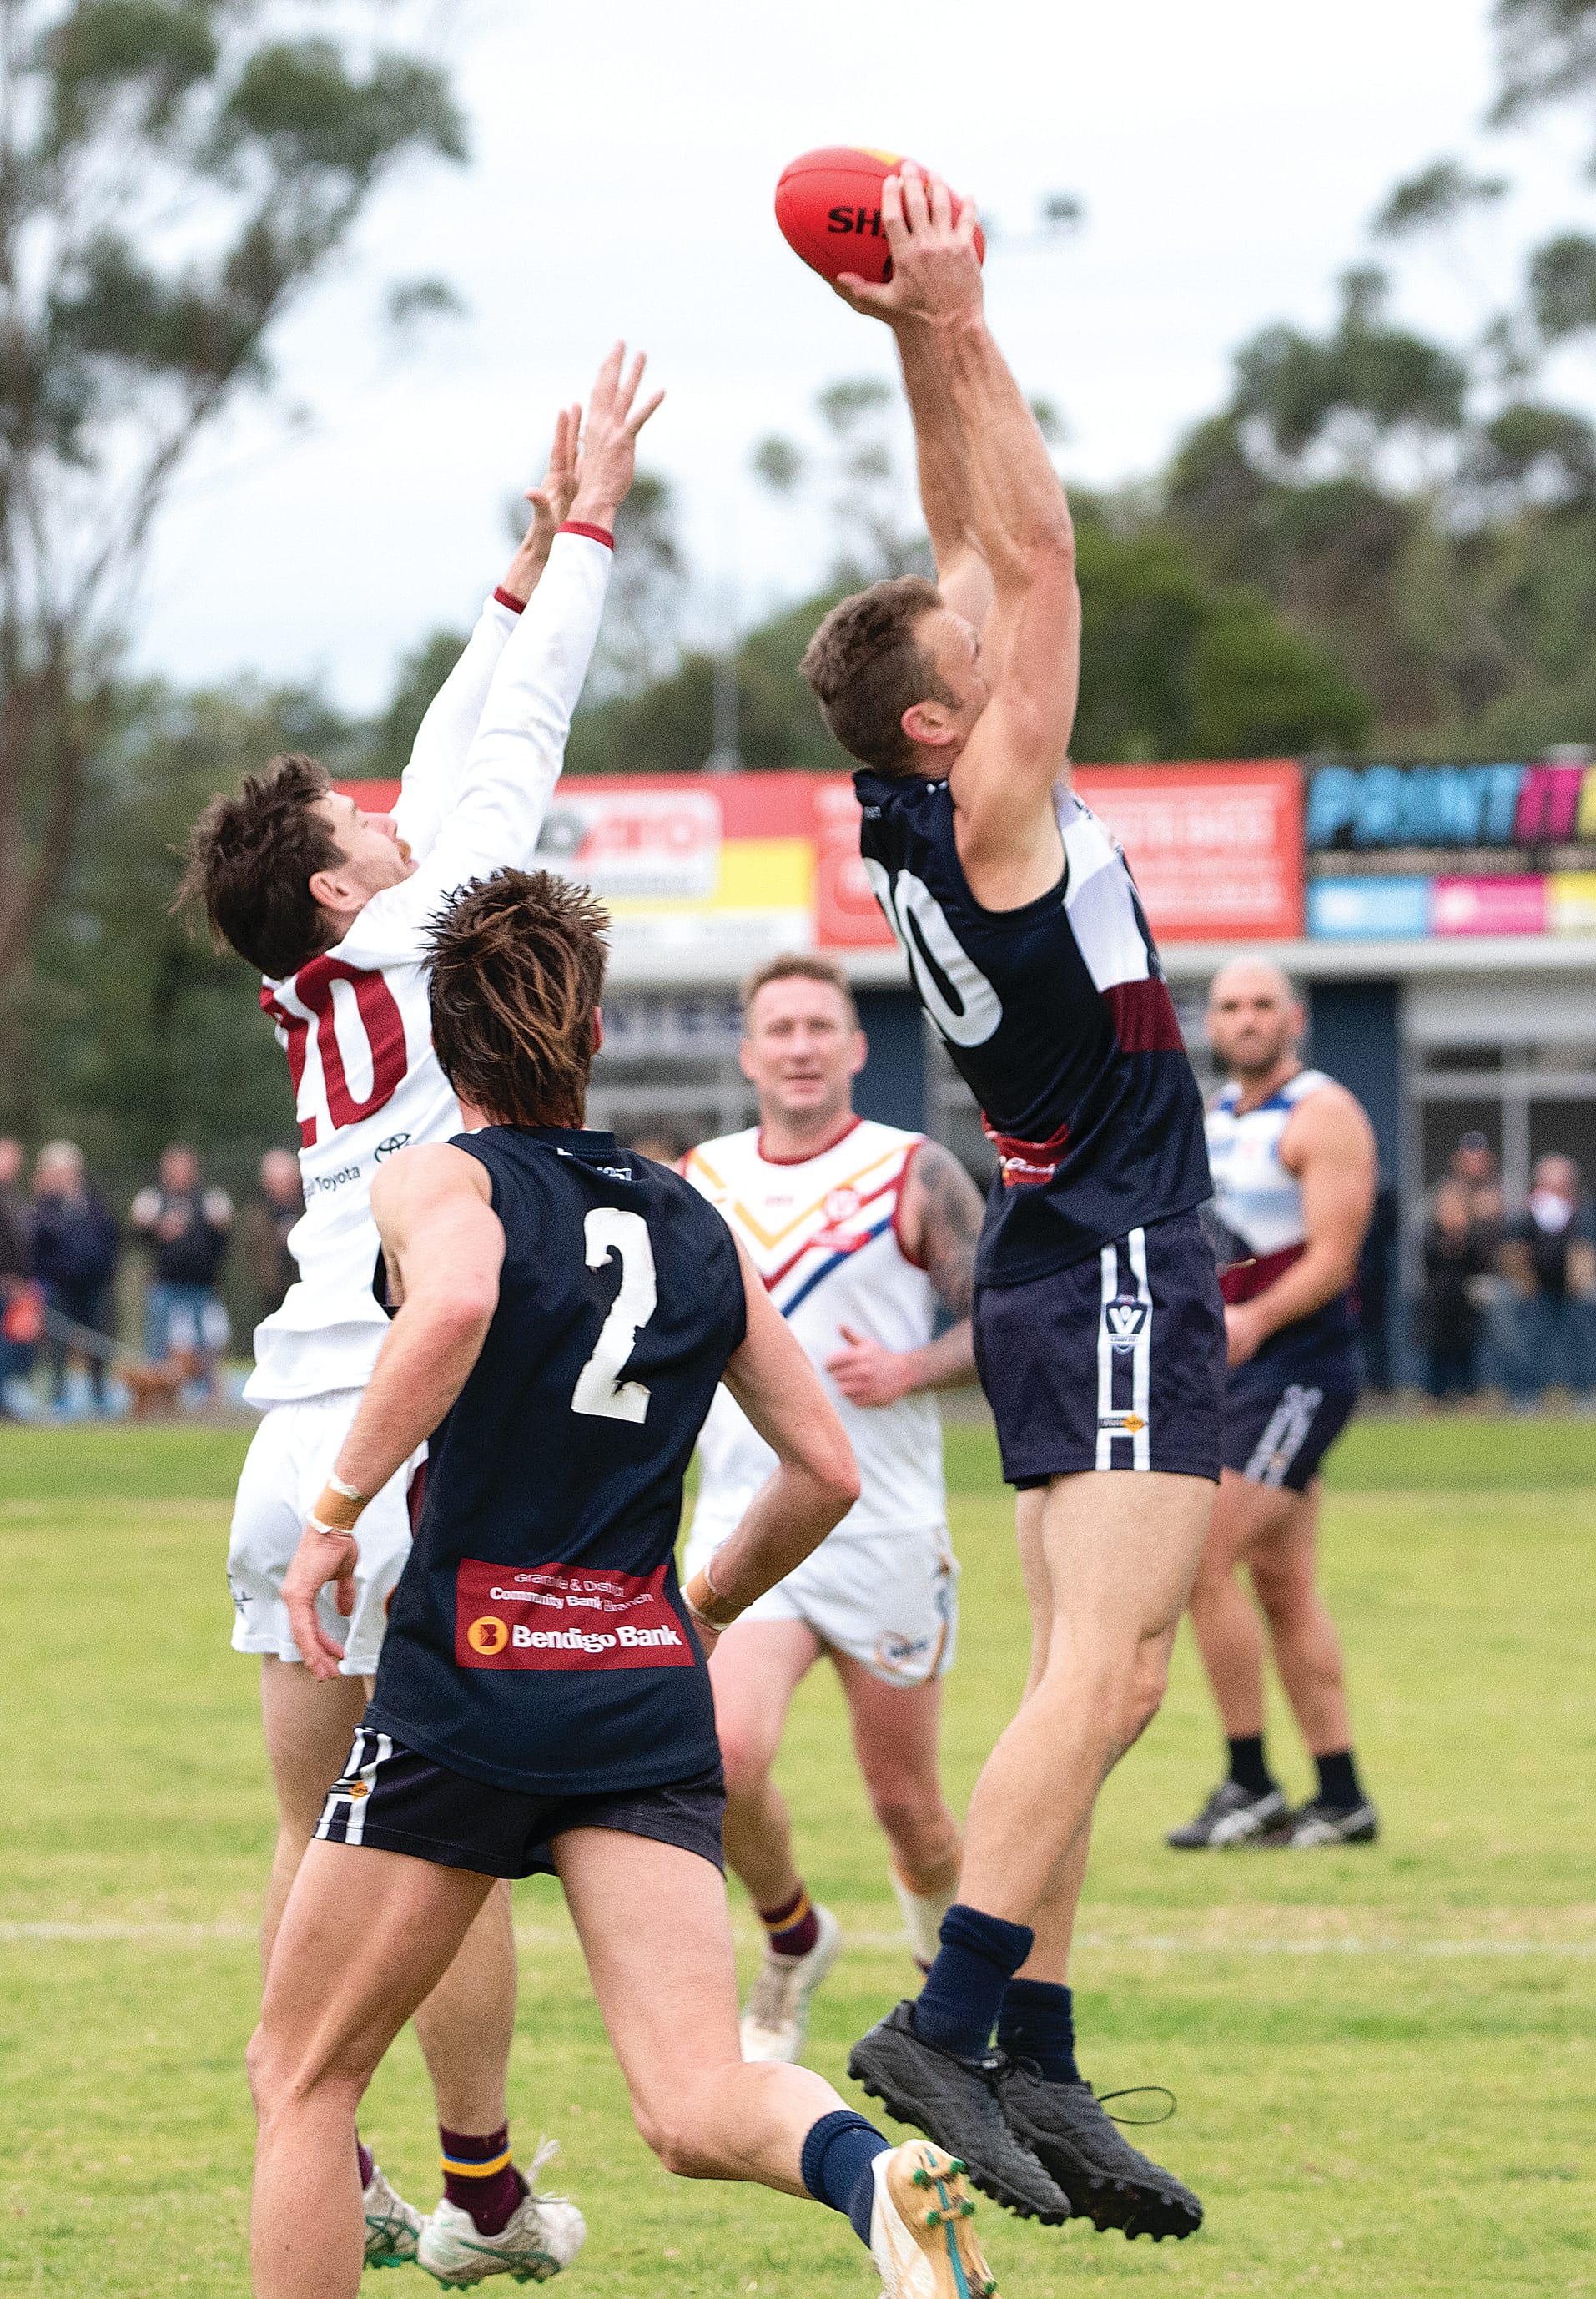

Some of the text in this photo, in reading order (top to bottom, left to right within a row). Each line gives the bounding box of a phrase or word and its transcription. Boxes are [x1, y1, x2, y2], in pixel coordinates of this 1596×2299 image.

[315, 1167, 360, 1193] Toyota
[571, 1207, 657, 1424] 2
[566, 1596, 603, 1611] Bank
[602, 1593, 654, 1612] Branch
[511, 1624, 617, 1653] Bendigo
[617, 1625, 682, 1648] Bank
